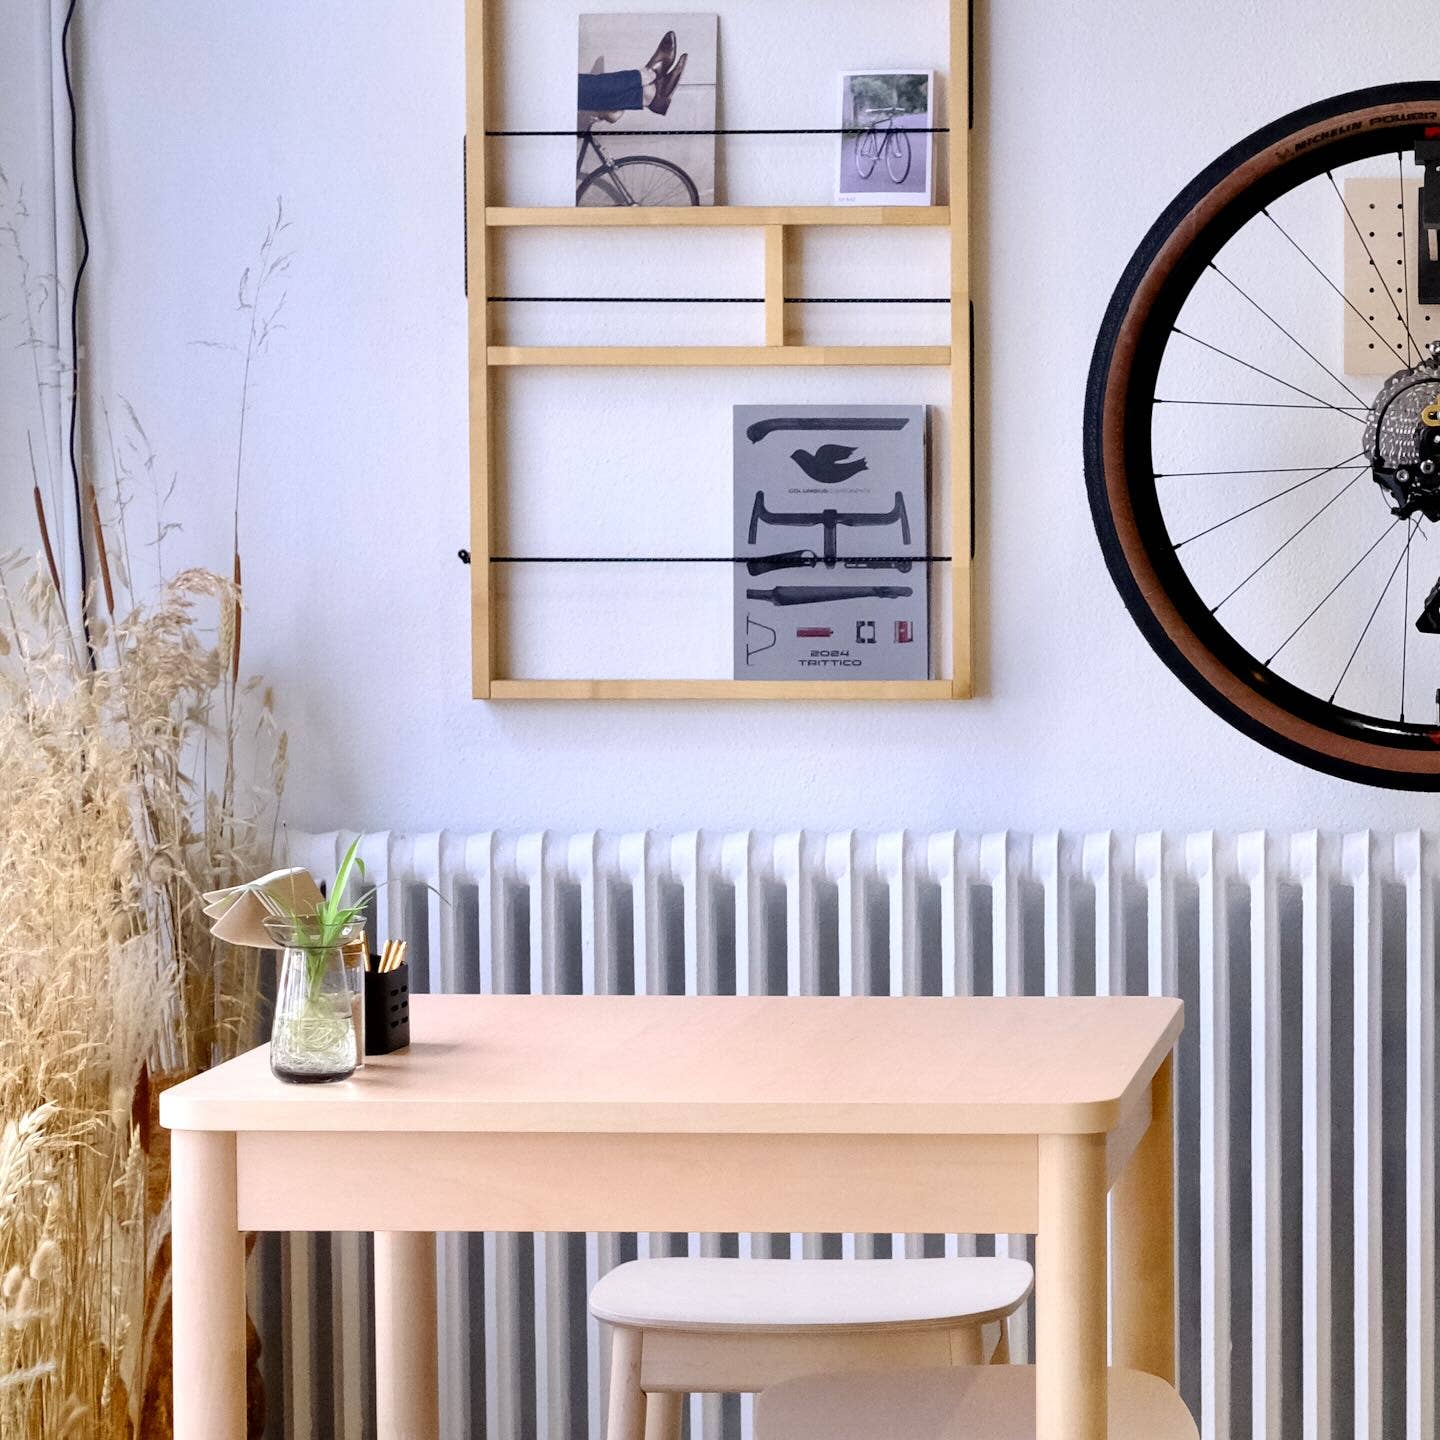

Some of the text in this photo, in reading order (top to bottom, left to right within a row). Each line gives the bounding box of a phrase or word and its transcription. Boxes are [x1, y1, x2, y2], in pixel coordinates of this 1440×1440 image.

[1294, 121, 1362, 152] MICHELIN
[1369, 111, 1438, 127] POWER
[810, 649, 850, 657] 2024
[797, 659, 862, 667] TRITTICO
